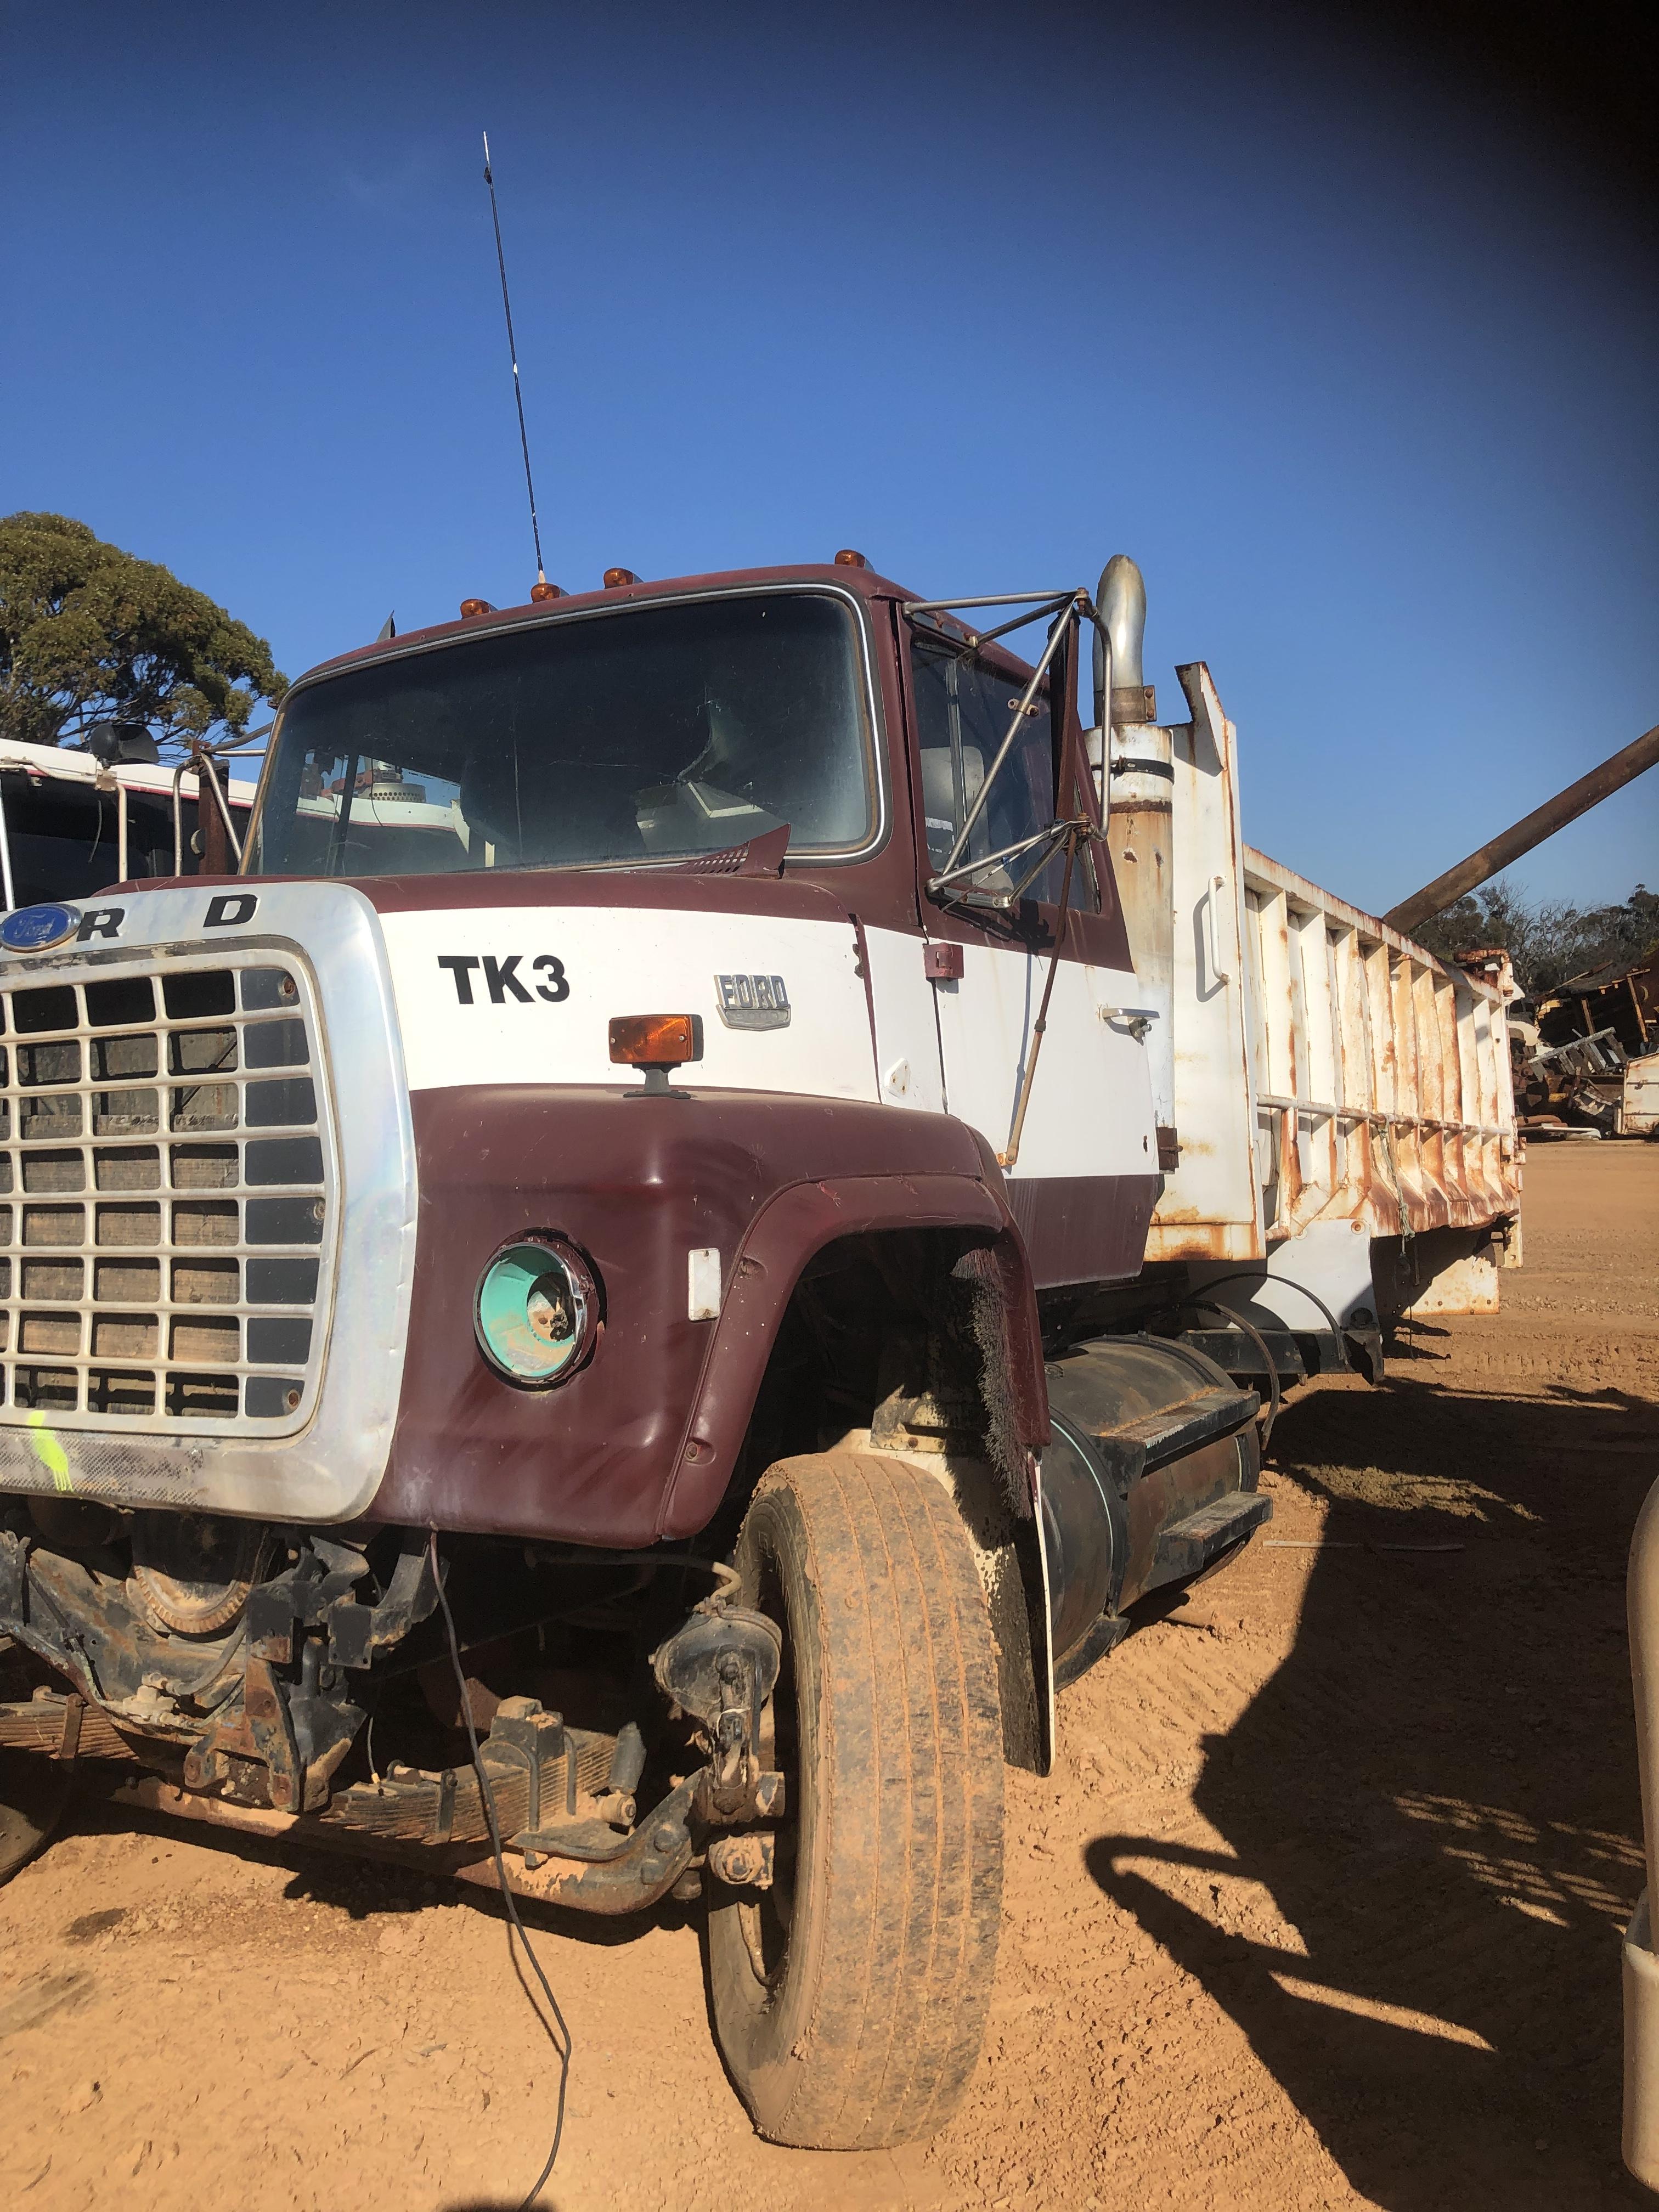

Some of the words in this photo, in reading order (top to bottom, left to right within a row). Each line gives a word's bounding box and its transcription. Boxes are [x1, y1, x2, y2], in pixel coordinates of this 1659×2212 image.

[13, 913, 55, 939] Ford
[438, 955, 570, 1005] TK3
[714, 974, 788, 1008] FORD
